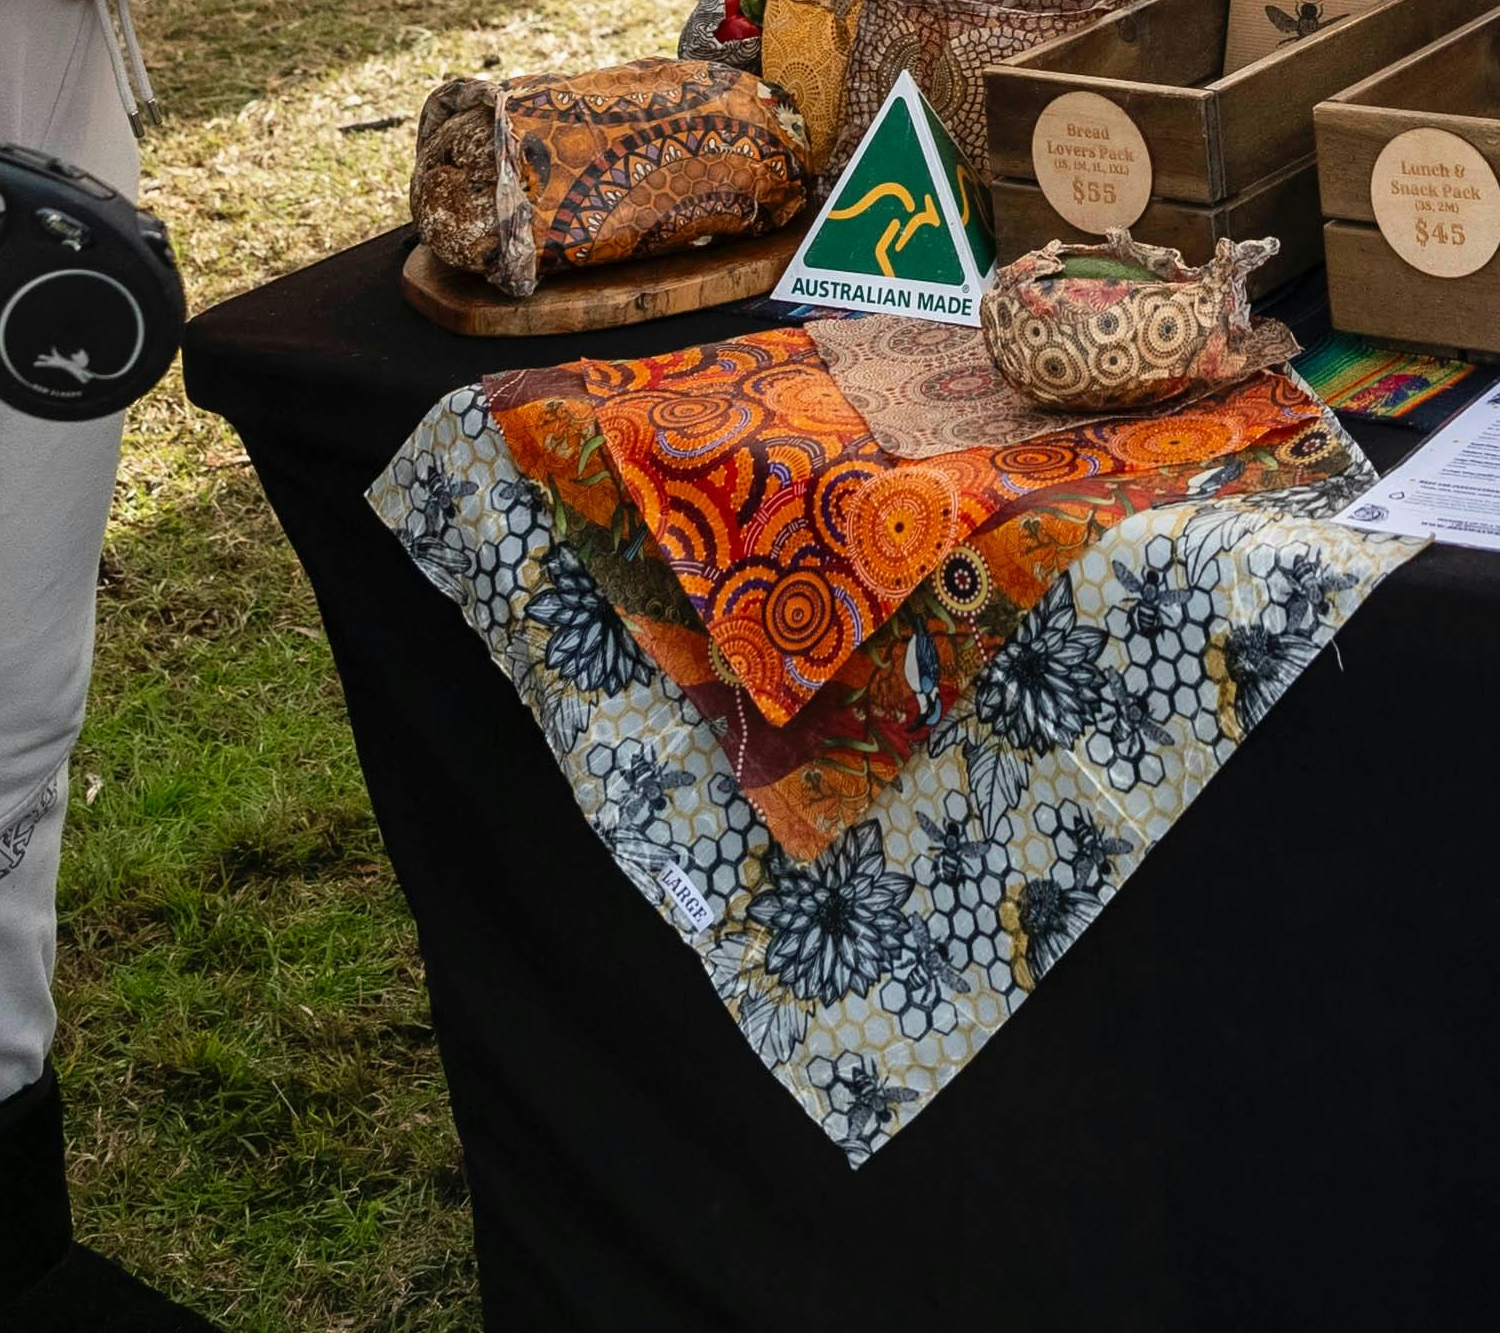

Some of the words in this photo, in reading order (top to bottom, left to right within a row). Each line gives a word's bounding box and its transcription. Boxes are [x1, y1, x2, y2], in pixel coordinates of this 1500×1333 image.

[1067, 123, 1110, 140] Bread
[1046, 141, 1096, 158] Lovers
[1099, 146, 1134, 162] Pack
[1401, 160, 1450, 177] Lunch
[1454, 164, 1465, 178] &
[1072, 175, 1117, 205] $55
[1391, 180, 1439, 198] Snack
[1442, 183, 1481, 200] Pack
[1415, 200, 1436, 212] (3S,
[1438, 202, 1459, 213] 2M)
[1415, 217, 1466, 247] $45
[791, 277, 912, 311] AUSTRALIAN
[916, 288, 973, 317] MADE
